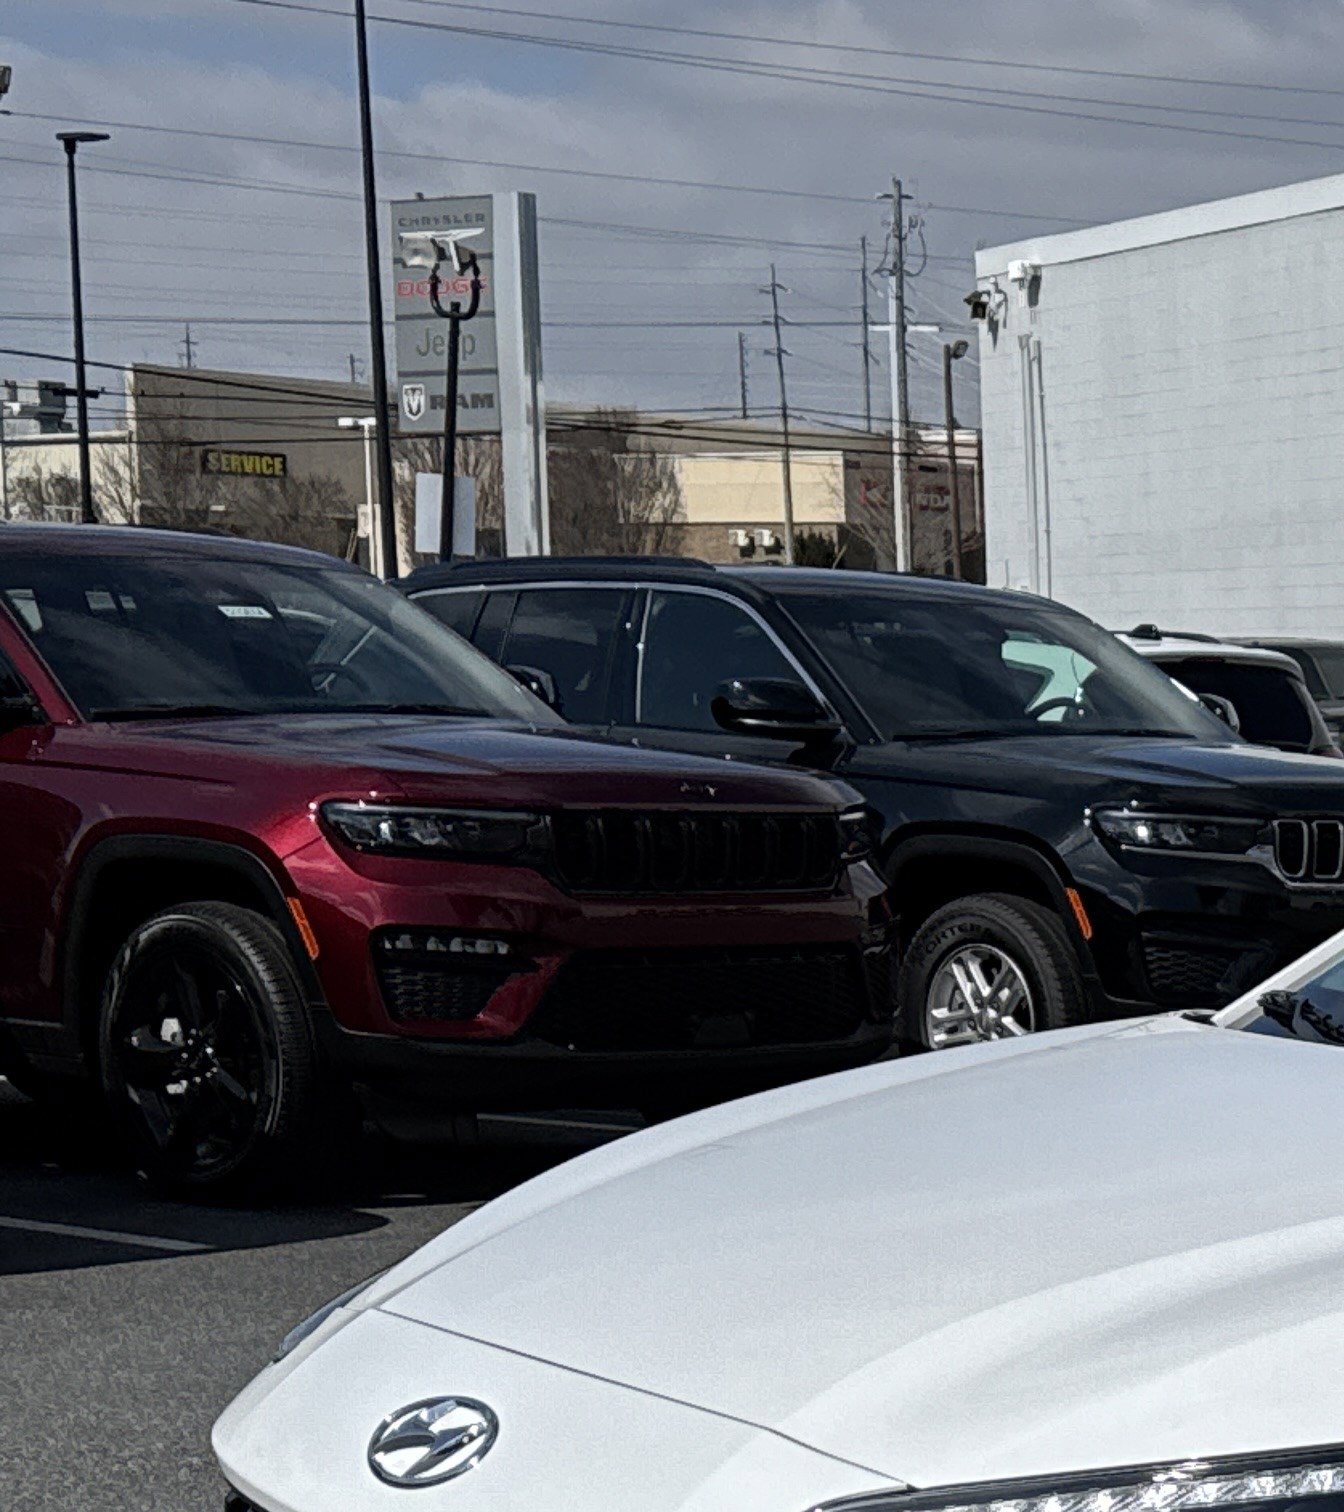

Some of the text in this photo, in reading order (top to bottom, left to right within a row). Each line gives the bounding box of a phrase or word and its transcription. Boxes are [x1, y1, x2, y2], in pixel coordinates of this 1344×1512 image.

[397, 212, 486, 227] CHRYSLER
[416, 327, 476, 361] Jep
[429, 392, 494, 410] RAM
[206, 451, 285, 476] SERVICE
